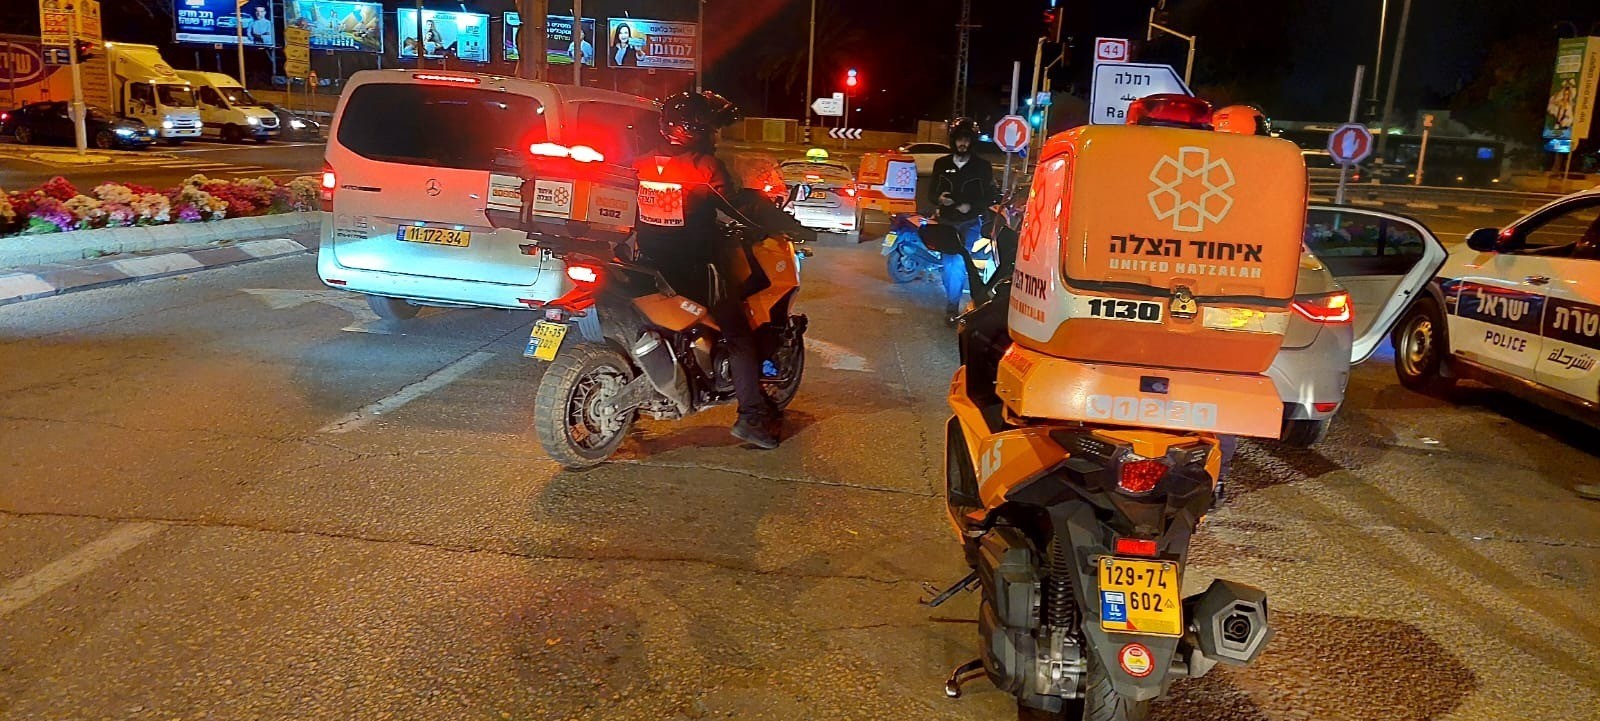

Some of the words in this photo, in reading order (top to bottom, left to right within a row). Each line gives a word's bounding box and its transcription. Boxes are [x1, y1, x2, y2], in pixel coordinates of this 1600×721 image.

[649, 43, 693, 56] למזומן
[1103, 45, 1120, 56] 44
[1114, 72, 1151, 87] רמלה
[1109, 234, 1183, 258] הצלה
[1188, 241, 1263, 264] איחוד
[1109, 258, 1169, 273] UNITED
[1175, 261, 1262, 279] HATZALAH
[1024, 273, 1047, 300] איחוד
[1088, 298, 1161, 321] 1130
[1476, 287, 1530, 321] ישראל
[1553, 306, 1600, 337] טרת
[1484, 330, 1527, 352] POLICE
[1547, 347, 1596, 371] الشرطة
[1130, 591, 1163, 612] 602
